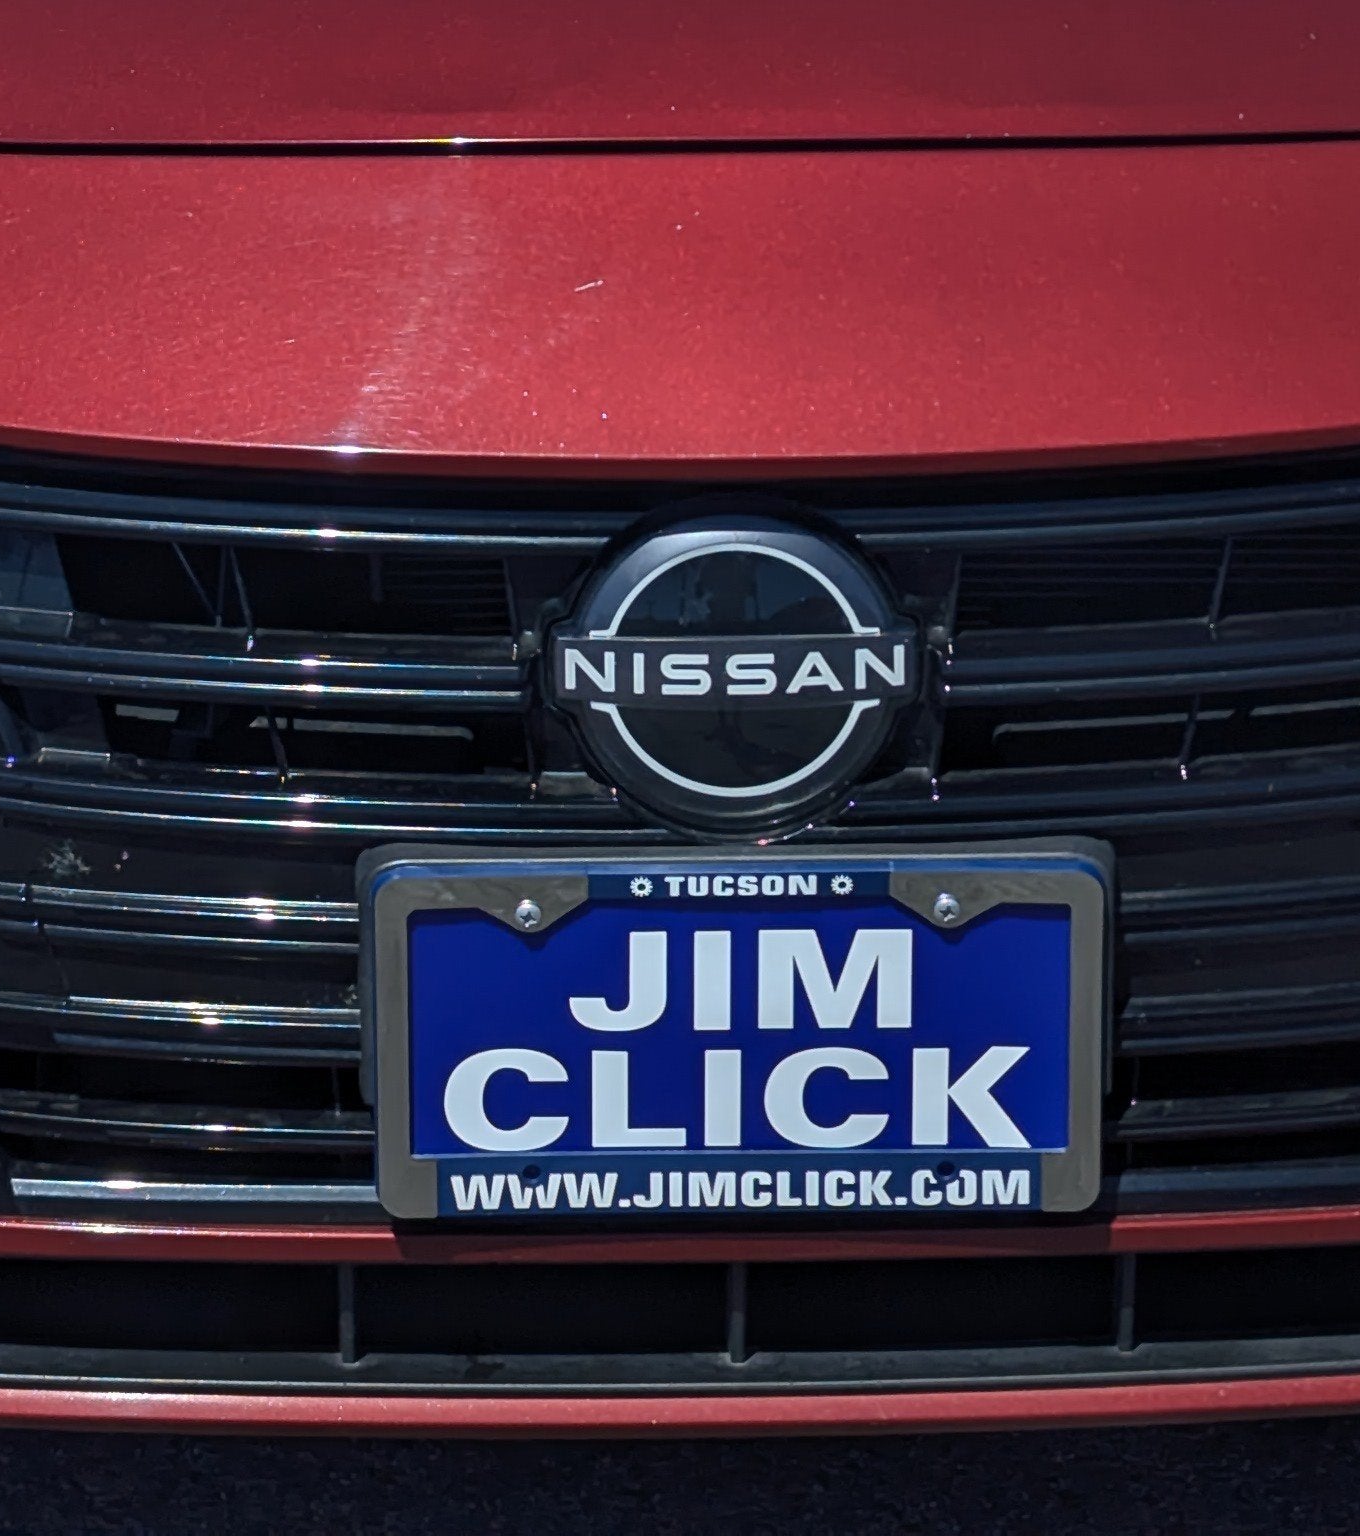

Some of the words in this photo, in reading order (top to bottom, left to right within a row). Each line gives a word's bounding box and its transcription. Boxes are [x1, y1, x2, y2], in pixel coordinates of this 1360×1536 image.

[565, 645, 906, 696] NISSAN
[665, 874, 818, 897] TUCSON
[569, 928, 913, 1031] JIM
[443, 1046, 1032, 1151] CLICK
[450, 1169, 1031, 1210] WWW.JIMCLICK.COM
